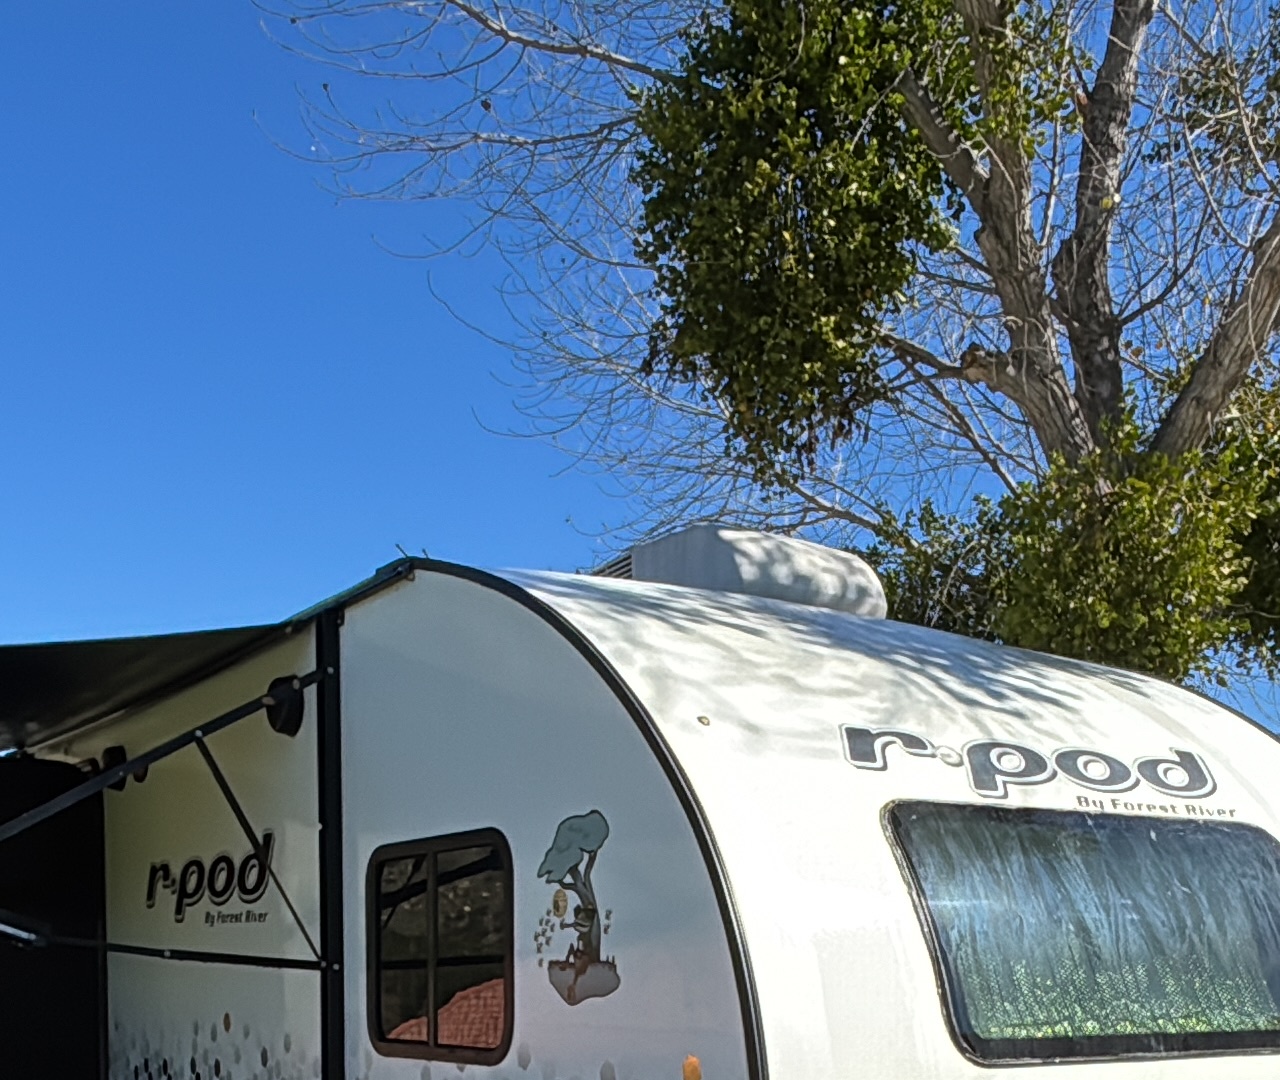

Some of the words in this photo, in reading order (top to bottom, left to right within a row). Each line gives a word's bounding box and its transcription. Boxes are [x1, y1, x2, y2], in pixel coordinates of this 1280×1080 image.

[1076, 795, 1104, 812] By
[1110, 798, 1179, 815] Forest
[1184, 804, 1236, 818] River
